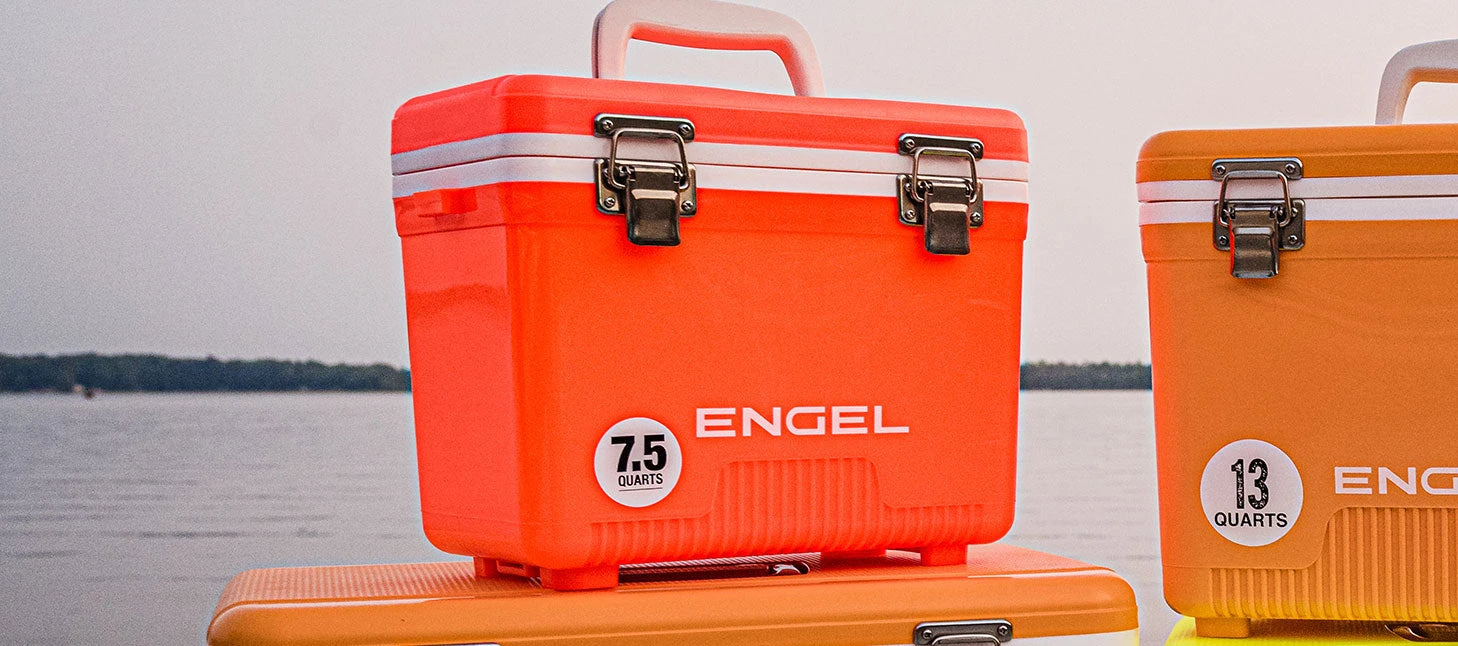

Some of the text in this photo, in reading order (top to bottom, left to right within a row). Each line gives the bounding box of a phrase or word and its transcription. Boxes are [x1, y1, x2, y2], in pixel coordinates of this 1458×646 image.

[695, 405, 910, 438] ENGEL
[611, 434, 667, 473] 7.5
[618, 473, 664, 487] QUARTS
[1231, 458, 1270, 510] 13
[1214, 512, 1288, 528] QUARTS
